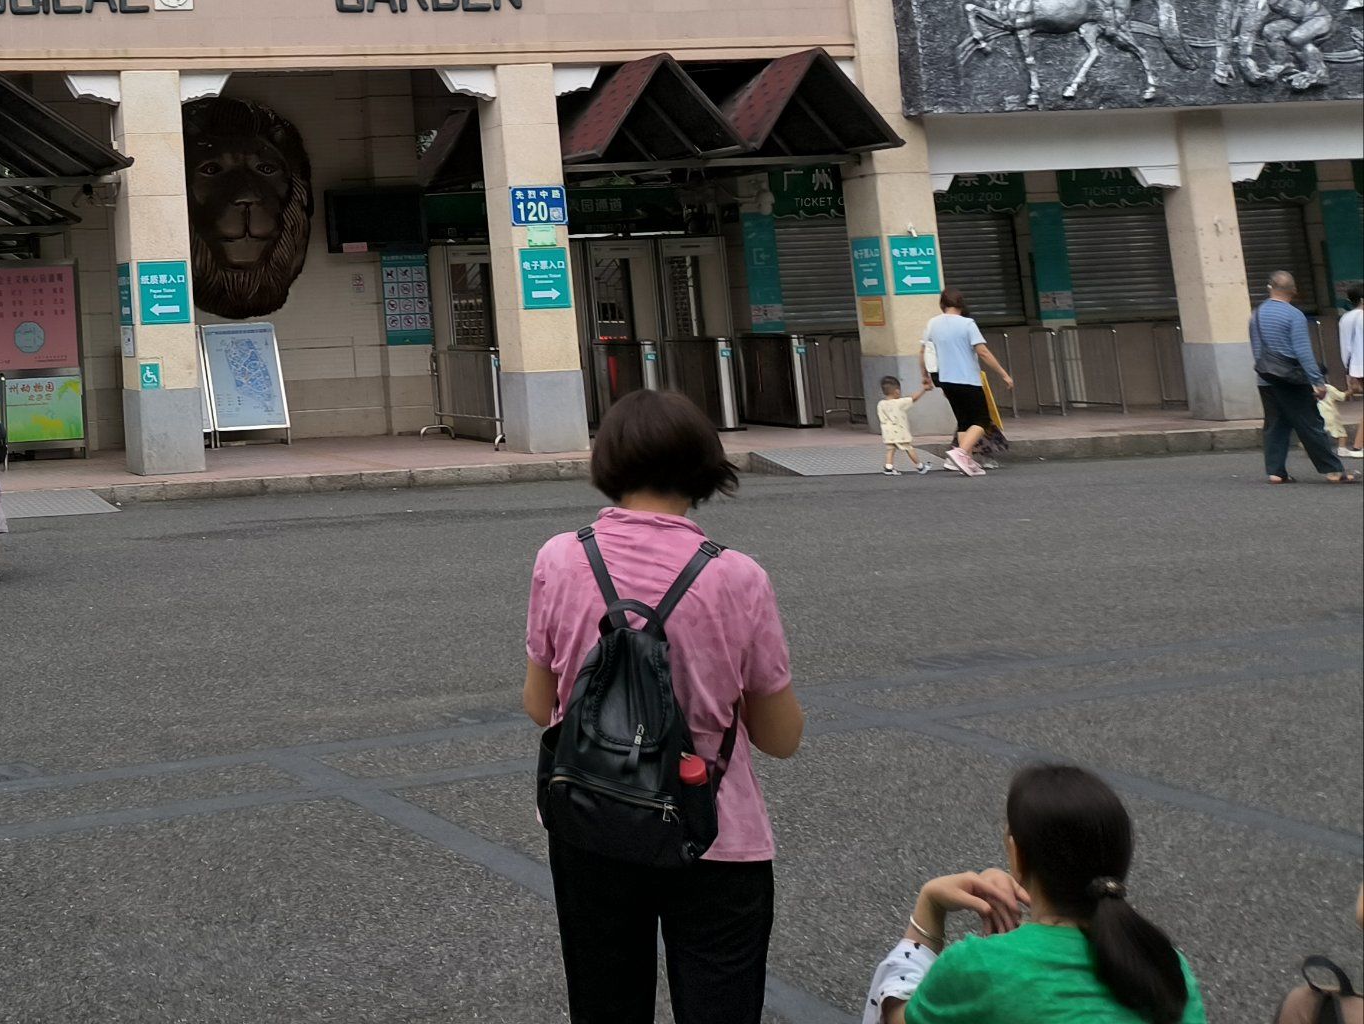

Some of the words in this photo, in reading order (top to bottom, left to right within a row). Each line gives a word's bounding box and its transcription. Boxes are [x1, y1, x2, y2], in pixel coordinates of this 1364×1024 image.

[515, 189, 561, 200] 先烈中路
[794, 196, 833, 207] TICKET
[517, 201, 549, 222] 120
[891, 247, 935, 258] 电子票入口
[522, 260, 566, 271] 电子票入口
[139, 274, 186, 285] 纸质票入口
